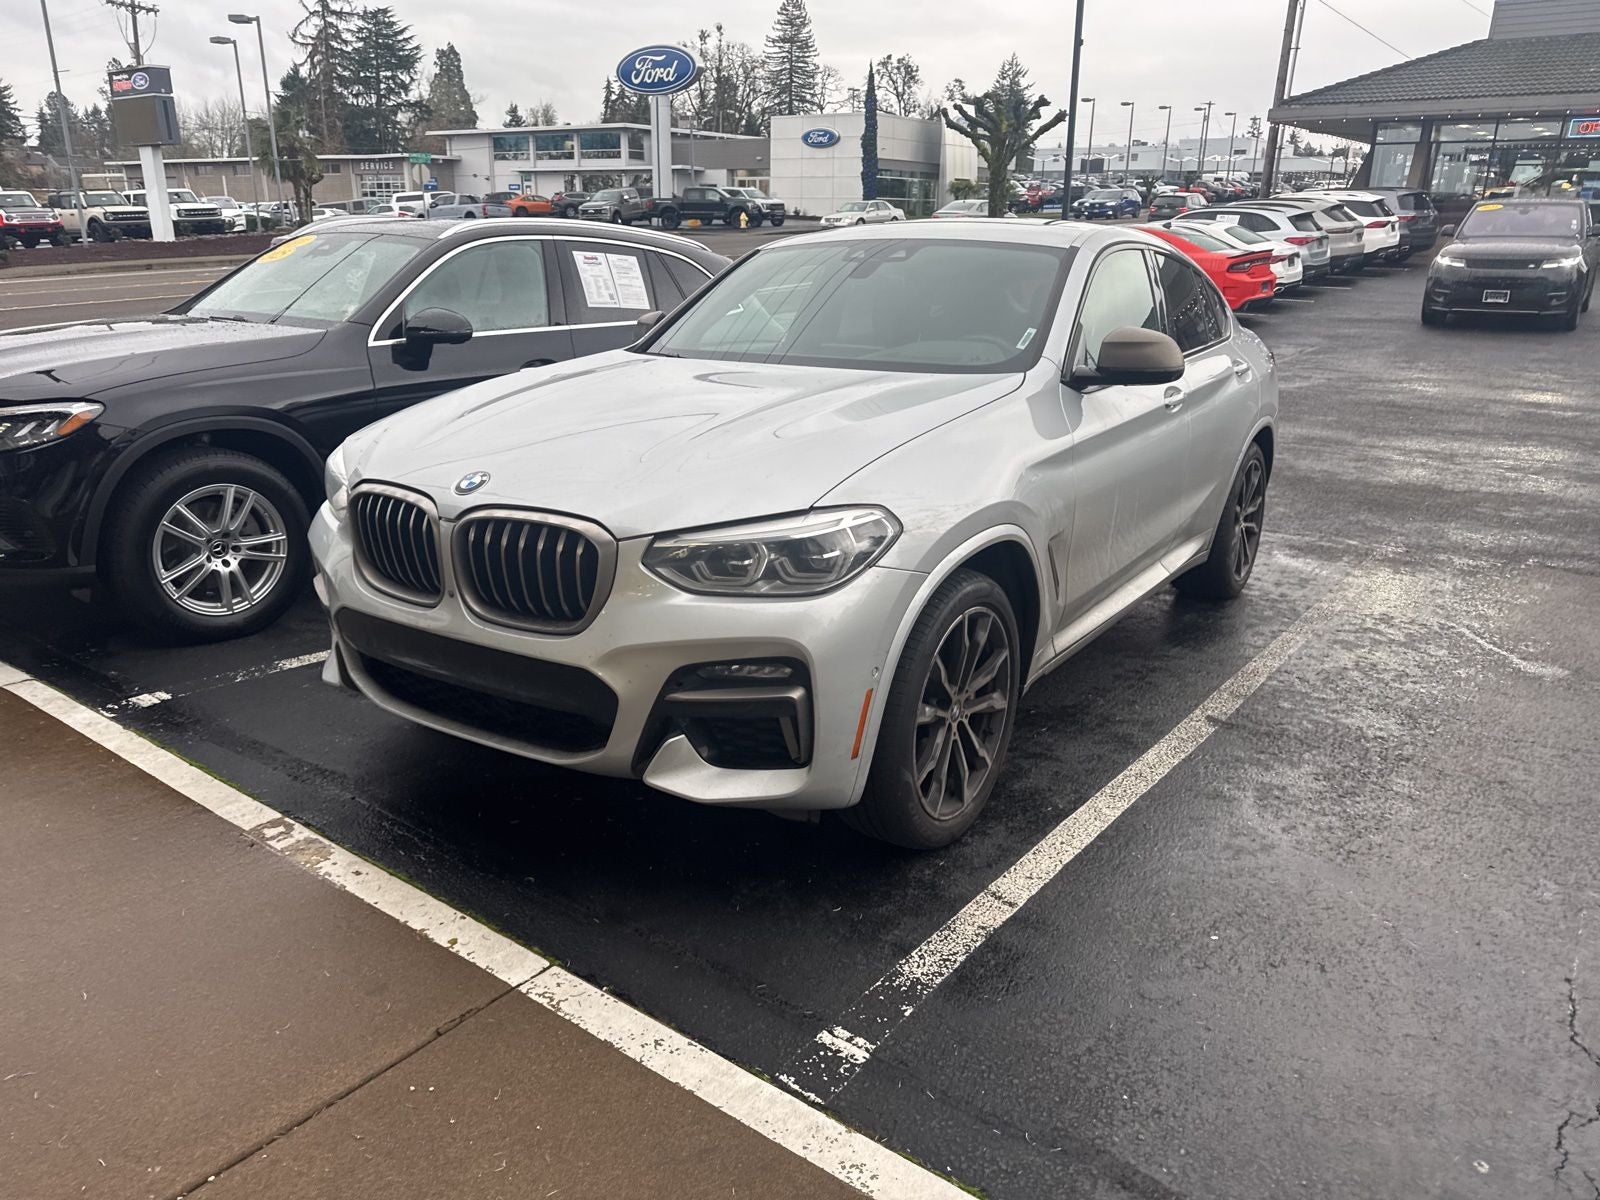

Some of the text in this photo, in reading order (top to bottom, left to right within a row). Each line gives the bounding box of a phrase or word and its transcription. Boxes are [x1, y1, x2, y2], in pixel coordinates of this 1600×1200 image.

[631, 55, 678, 84] Ford
[807, 131, 830, 143] Ford
[360, 161, 394, 170] SERVICE
